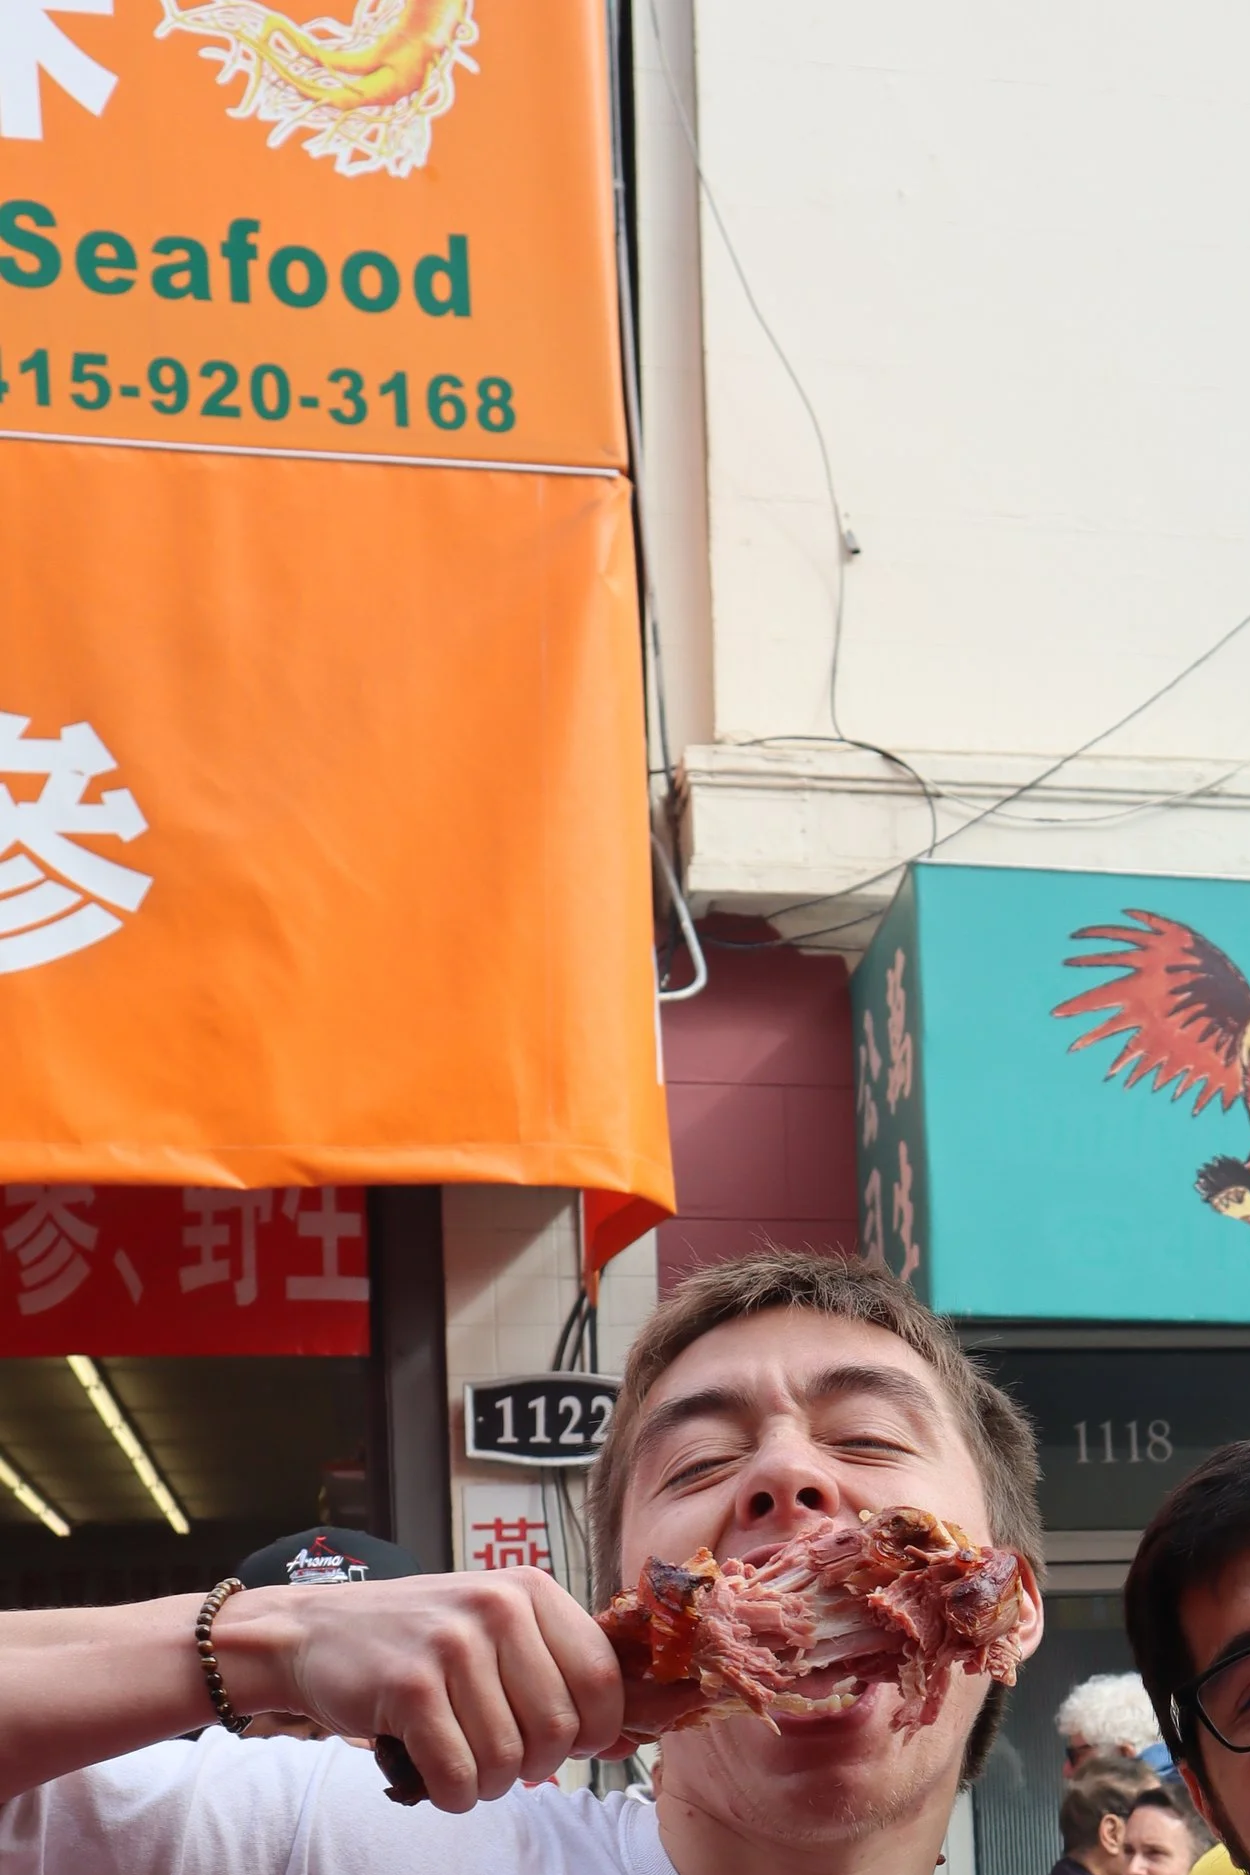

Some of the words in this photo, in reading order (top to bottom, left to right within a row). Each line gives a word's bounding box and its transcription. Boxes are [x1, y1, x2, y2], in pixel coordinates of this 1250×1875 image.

[0, 199, 472, 319] Seafood
[0, 347, 517, 434] 15-920-3168
[495, 1395, 616, 1445] 1122
[1072, 1418, 1174, 1464] 1118
[286, 1548, 344, 1573] Aroma
